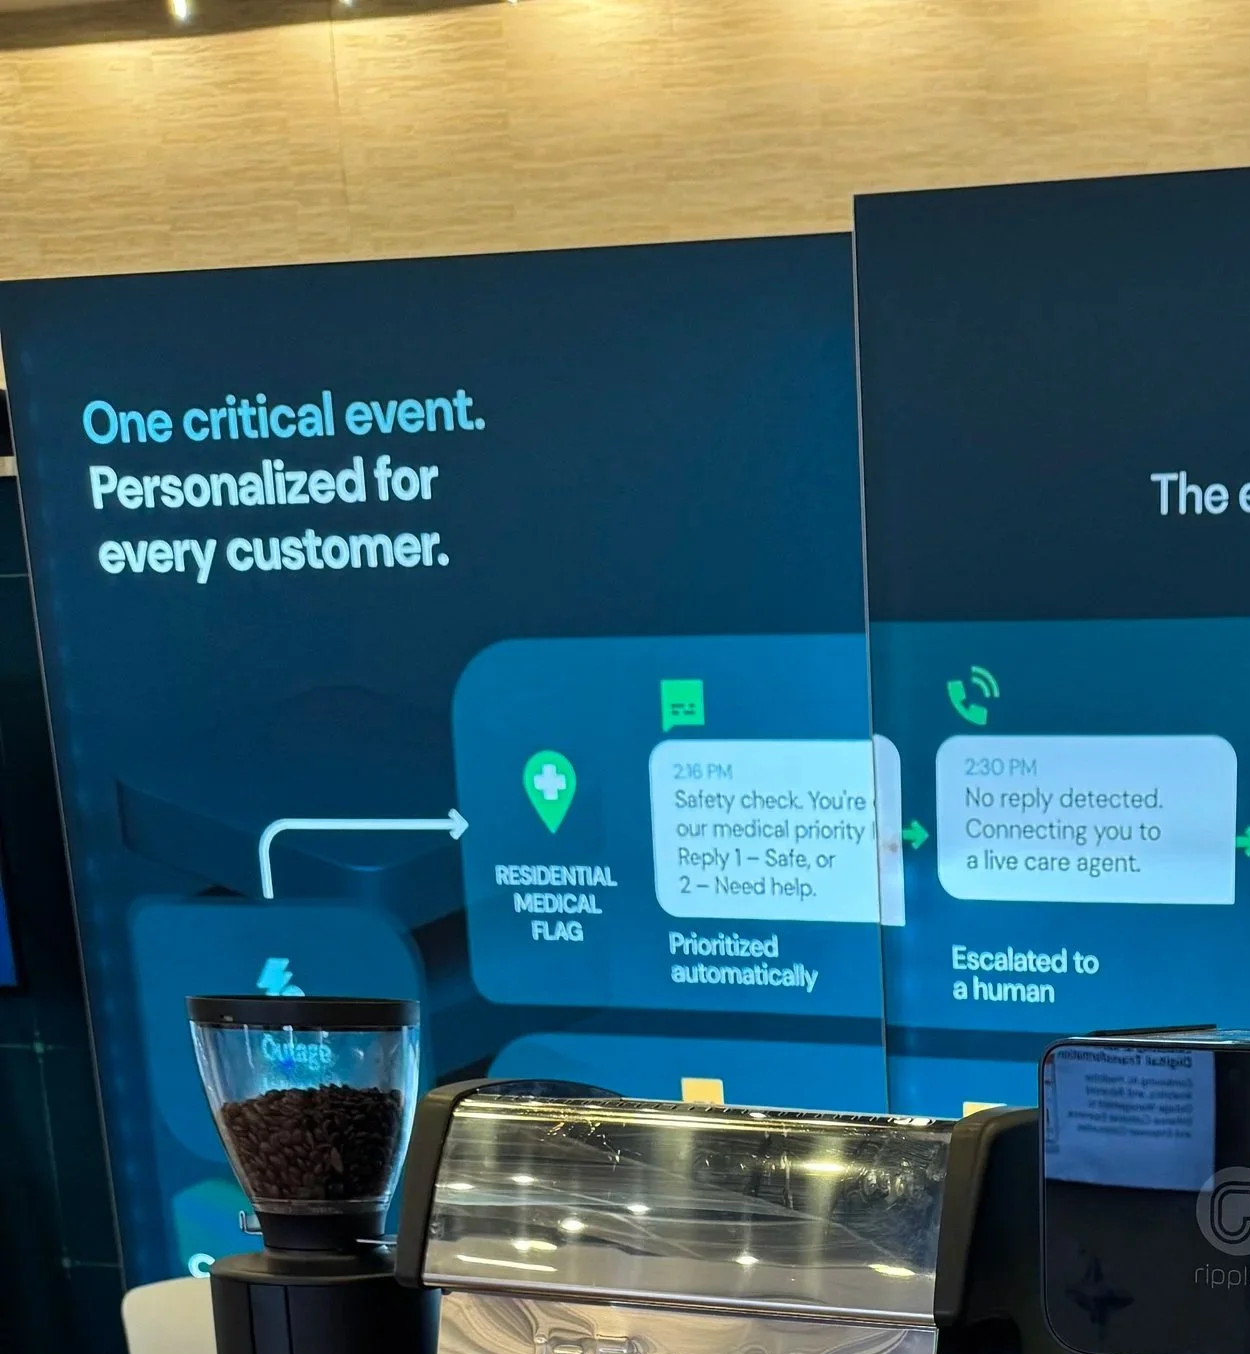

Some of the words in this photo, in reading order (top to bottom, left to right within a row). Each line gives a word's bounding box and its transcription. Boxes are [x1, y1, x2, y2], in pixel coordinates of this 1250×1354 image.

[83, 400, 173, 445] One
[183, 391, 333, 440] critical
[347, 388, 486, 436] event.
[90, 457, 365, 510] Personalized
[375, 456, 438, 502] for
[1151, 472, 1229, 516] The
[98, 537, 215, 584] every
[226, 530, 449, 571] customer.
[707, 763, 733, 780] PM
[965, 758, 1004, 776] 2:30
[1009, 758, 1037, 776] PM
[675, 789, 734, 813] Safety
[740, 790, 802, 810] check.
[808, 790, 867, 810] You're
[965, 787, 994, 808] No
[1000, 788, 1053, 814] reply
[1060, 788, 1163, 809] detected.
[677, 823, 706, 837] our
[713, 819, 789, 838] medical
[795, 819, 865, 844] priority
[965, 818, 1087, 846] Connecting
[1093, 825, 1132, 846] you
[1140, 823, 1161, 841] to
[679, 848, 730, 871] Reply
[734, 849, 742, 867] 1
[764, 848, 810, 870] Safe,
[816, 853, 837, 868] or
[967, 855, 979, 870] a
[984, 849, 1018, 871] live
[1025, 855, 1070, 871] care
[1077, 854, 1141, 877] agent.
[495, 864, 618, 887] RESIDENTIAL
[679, 876, 692, 894] 2
[715, 877, 766, 895] Need
[771, 879, 817, 901] help.
[514, 893, 602, 914] MEDICAL
[531, 920, 583, 941] FLAG
[669, 931, 779, 958] Prioritized
[951, 944, 1067, 973] Escalated
[1073, 951, 1099, 974] to
[671, 962, 818, 993] automatically
[953, 981, 968, 999] a
[973, 975, 1055, 1003] human
